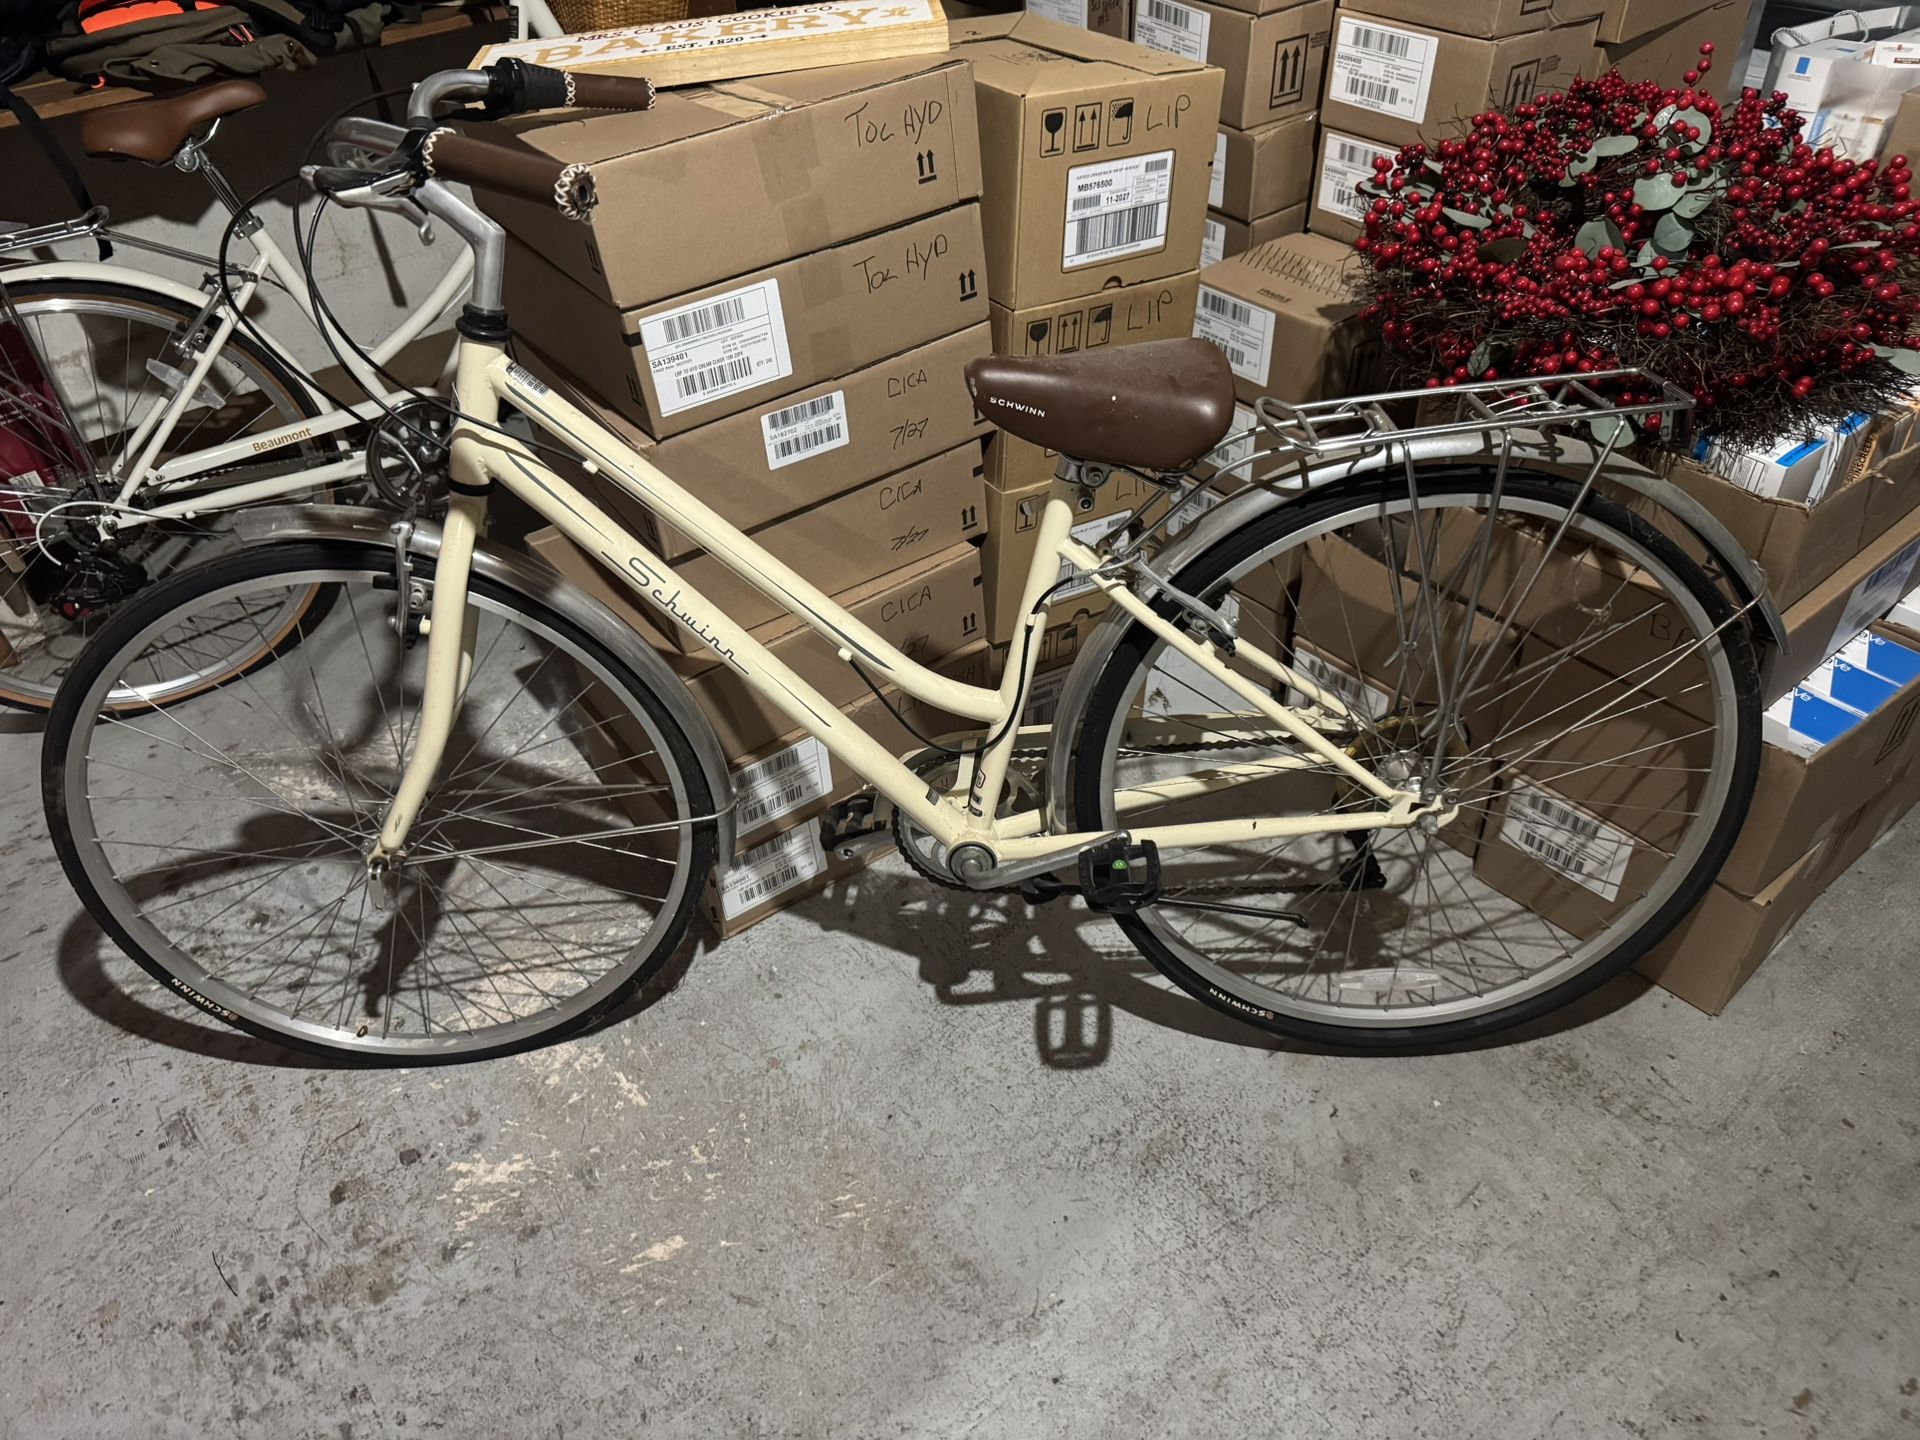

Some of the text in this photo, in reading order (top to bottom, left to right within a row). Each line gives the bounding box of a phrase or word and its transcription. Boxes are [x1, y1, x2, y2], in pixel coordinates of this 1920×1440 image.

[534, 7, 879, 65] BAKERY
[576, 31, 626, 43] MRS.
[717, 8, 798, 24] COOKIE
[803, 5, 841, 14] CO.
[664, 36, 745, 52] EST. 1820
[1145, 94, 1191, 132] LIP
[1077, 179, 1113, 193] MB576500
[1105, 192, 1130, 205] 11-2027
[1126, 290, 1173, 331] LIP
[651, 351, 688, 369] SA139401
[887, 368, 928, 398] CICA
[989, 396, 1046, 418] SCHWINN
[252, 427, 313, 452] Beaumont
[889, 417, 929, 451] 7/27
[879, 478, 922, 511] CICA
[600, 550, 750, 676] Schwinn
[880, 585, 932, 623] CICA
[171, 978, 231, 1017] SCHWINN
[1208, 987, 1266, 1017] SCHWINN
